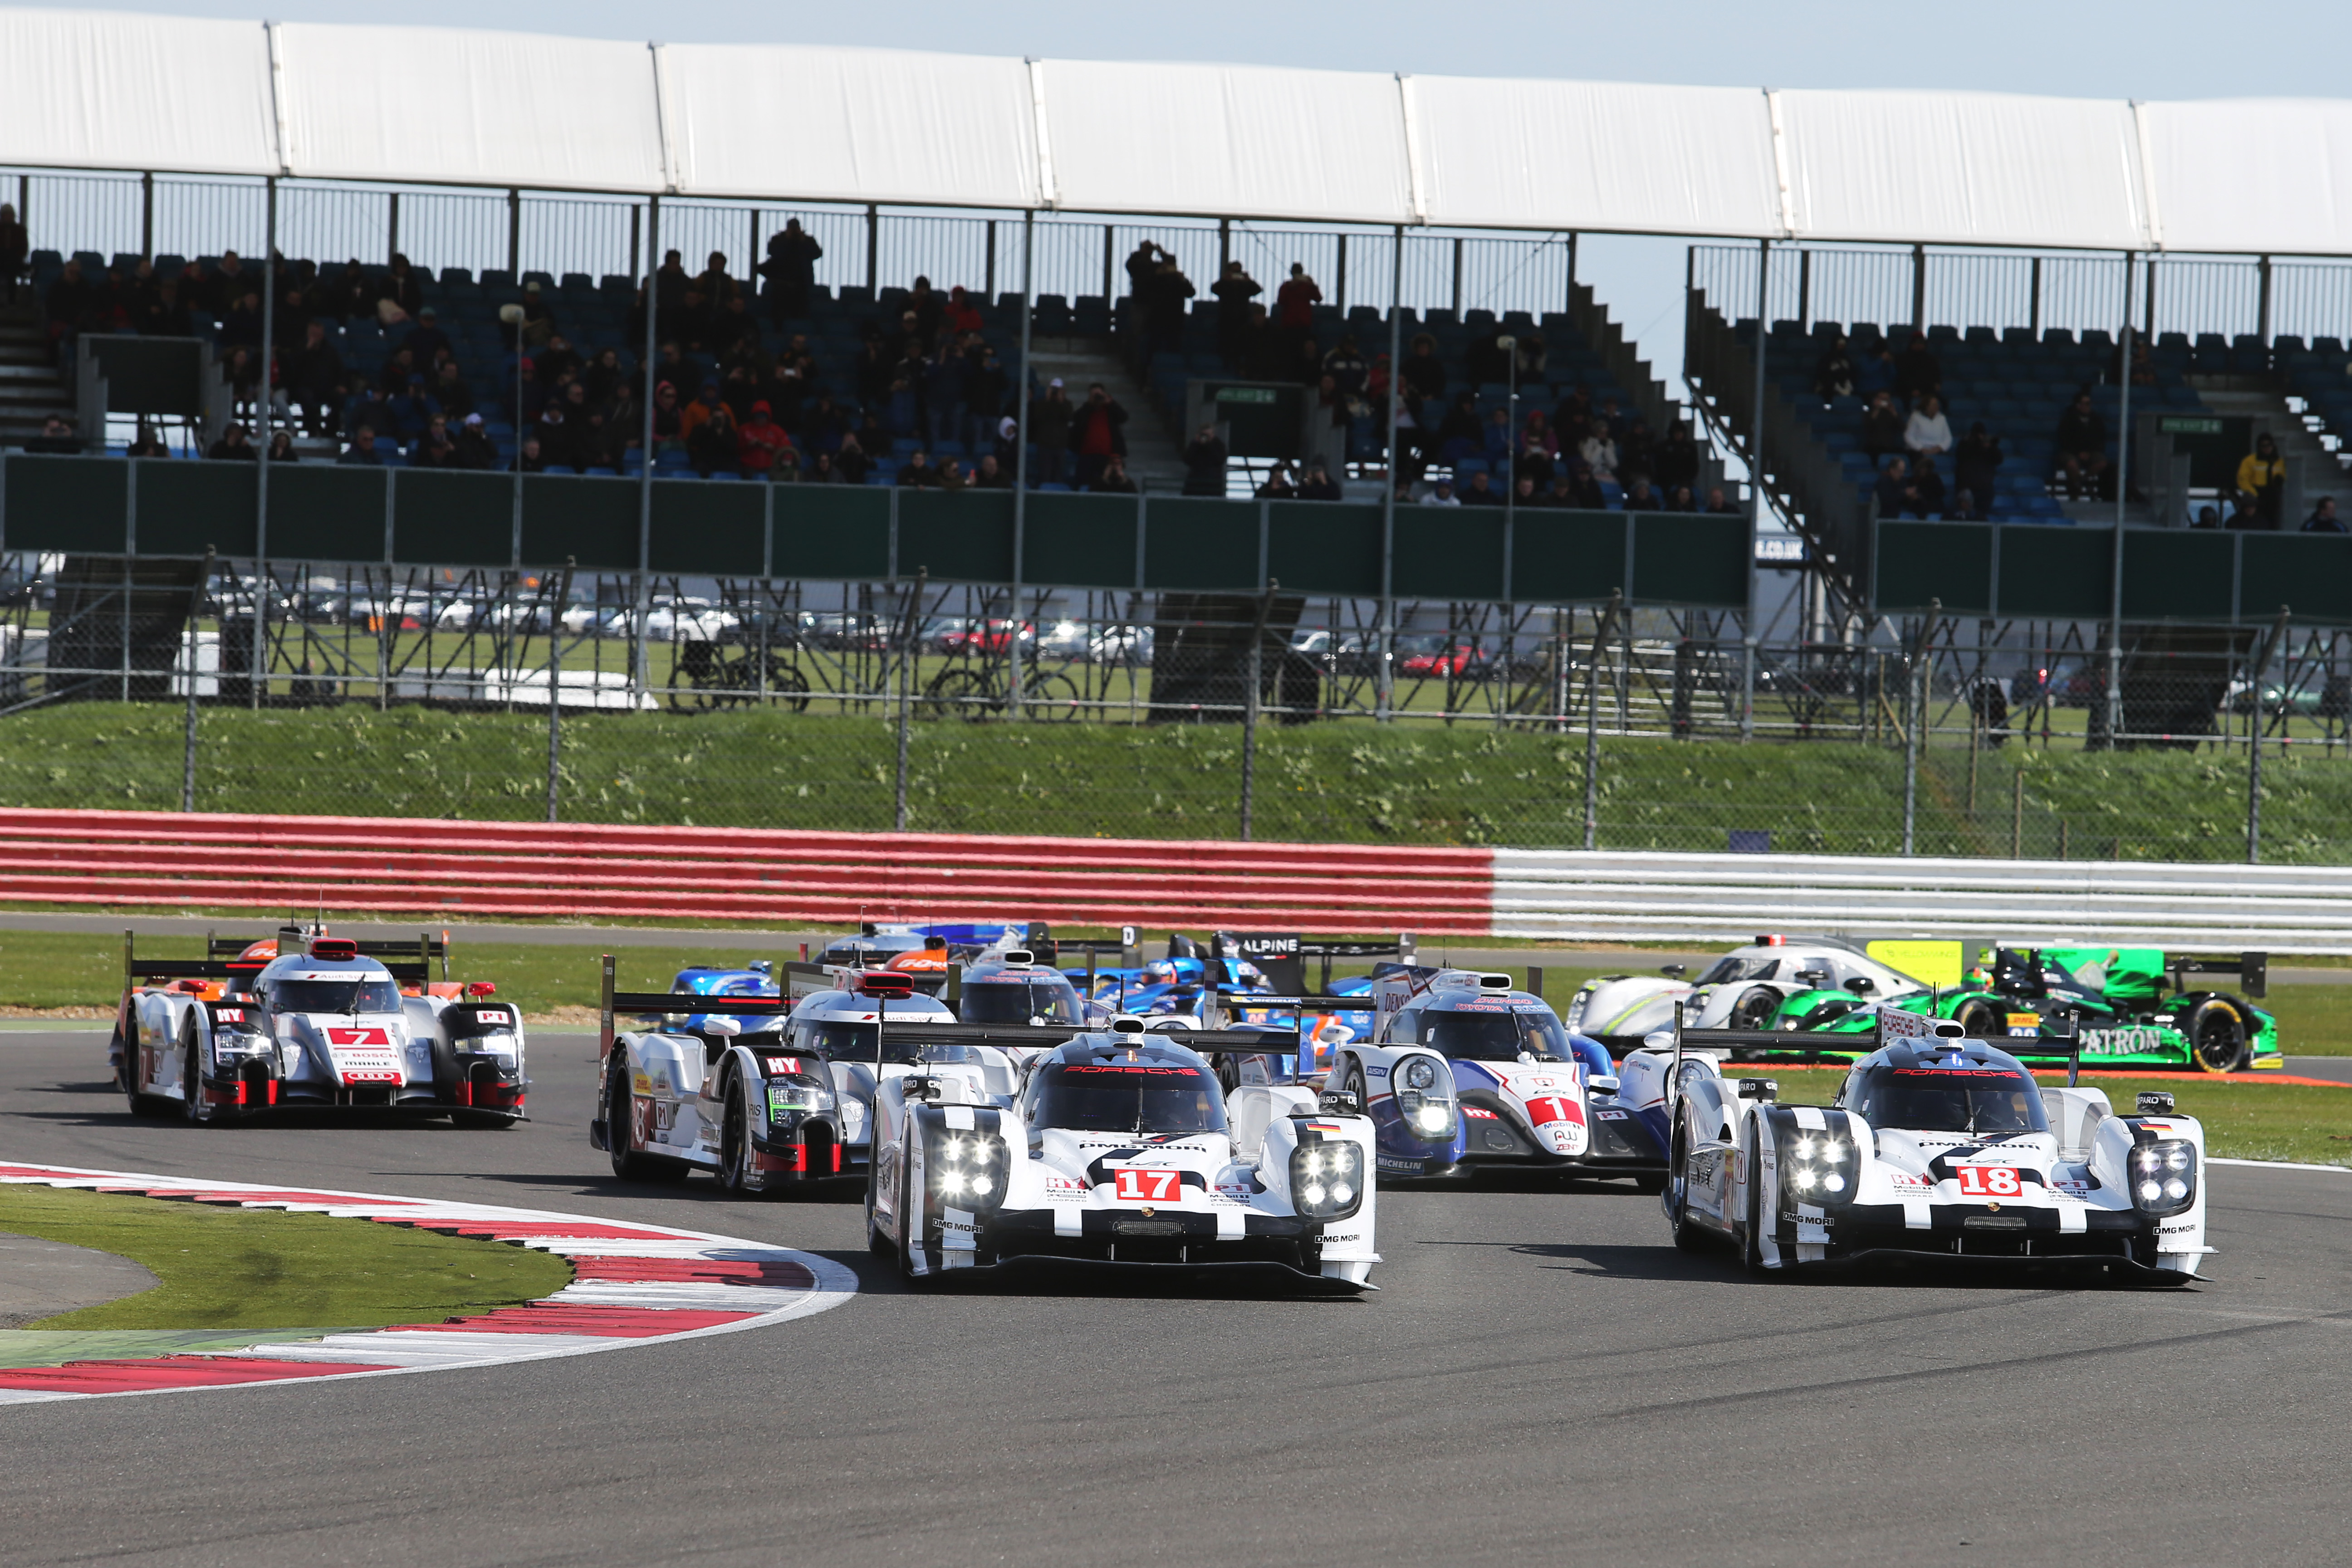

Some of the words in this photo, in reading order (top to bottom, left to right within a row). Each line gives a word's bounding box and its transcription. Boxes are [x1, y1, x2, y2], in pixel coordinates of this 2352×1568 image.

[1243, 939, 1298, 952] ALPINE
[1454, 1003, 1504, 1011] TOYOTA
[216, 1009, 241, 1022] HY
[482, 1013, 503, 1021] P1
[1884, 1013, 1914, 1037] PORSCHE
[345, 1031, 371, 1044] 7
[766, 1058, 796, 1073] HY
[1064, 1066, 1200, 1076] PORSCHE
[1893, 1068, 2022, 1078] PORSCHE
[1465, 1108, 1491, 1117] HY
[1544, 1098, 1567, 1120] 1
[658, 1106, 666, 1126] P1
[636, 1101, 645, 1144] 8
[1143, 1144, 1207, 1153] MORI
[1980, 1143, 2041, 1151] MORI
[1377, 1157, 1422, 1169] MICHELIN
[1048, 1177, 1082, 1188] HY
[1118, 1171, 1176, 1198] 17
[1891, 1174, 1924, 1185] HY
[1960, 1167, 2019, 1194] 18
[1784, 1213, 1803, 1223] DMG
[1805, 1216, 1833, 1225] MORI
[933, 1219, 953, 1229] DMG
[954, 1223, 983, 1233] MORI
[2178, 1224, 2196, 1233] MORI
